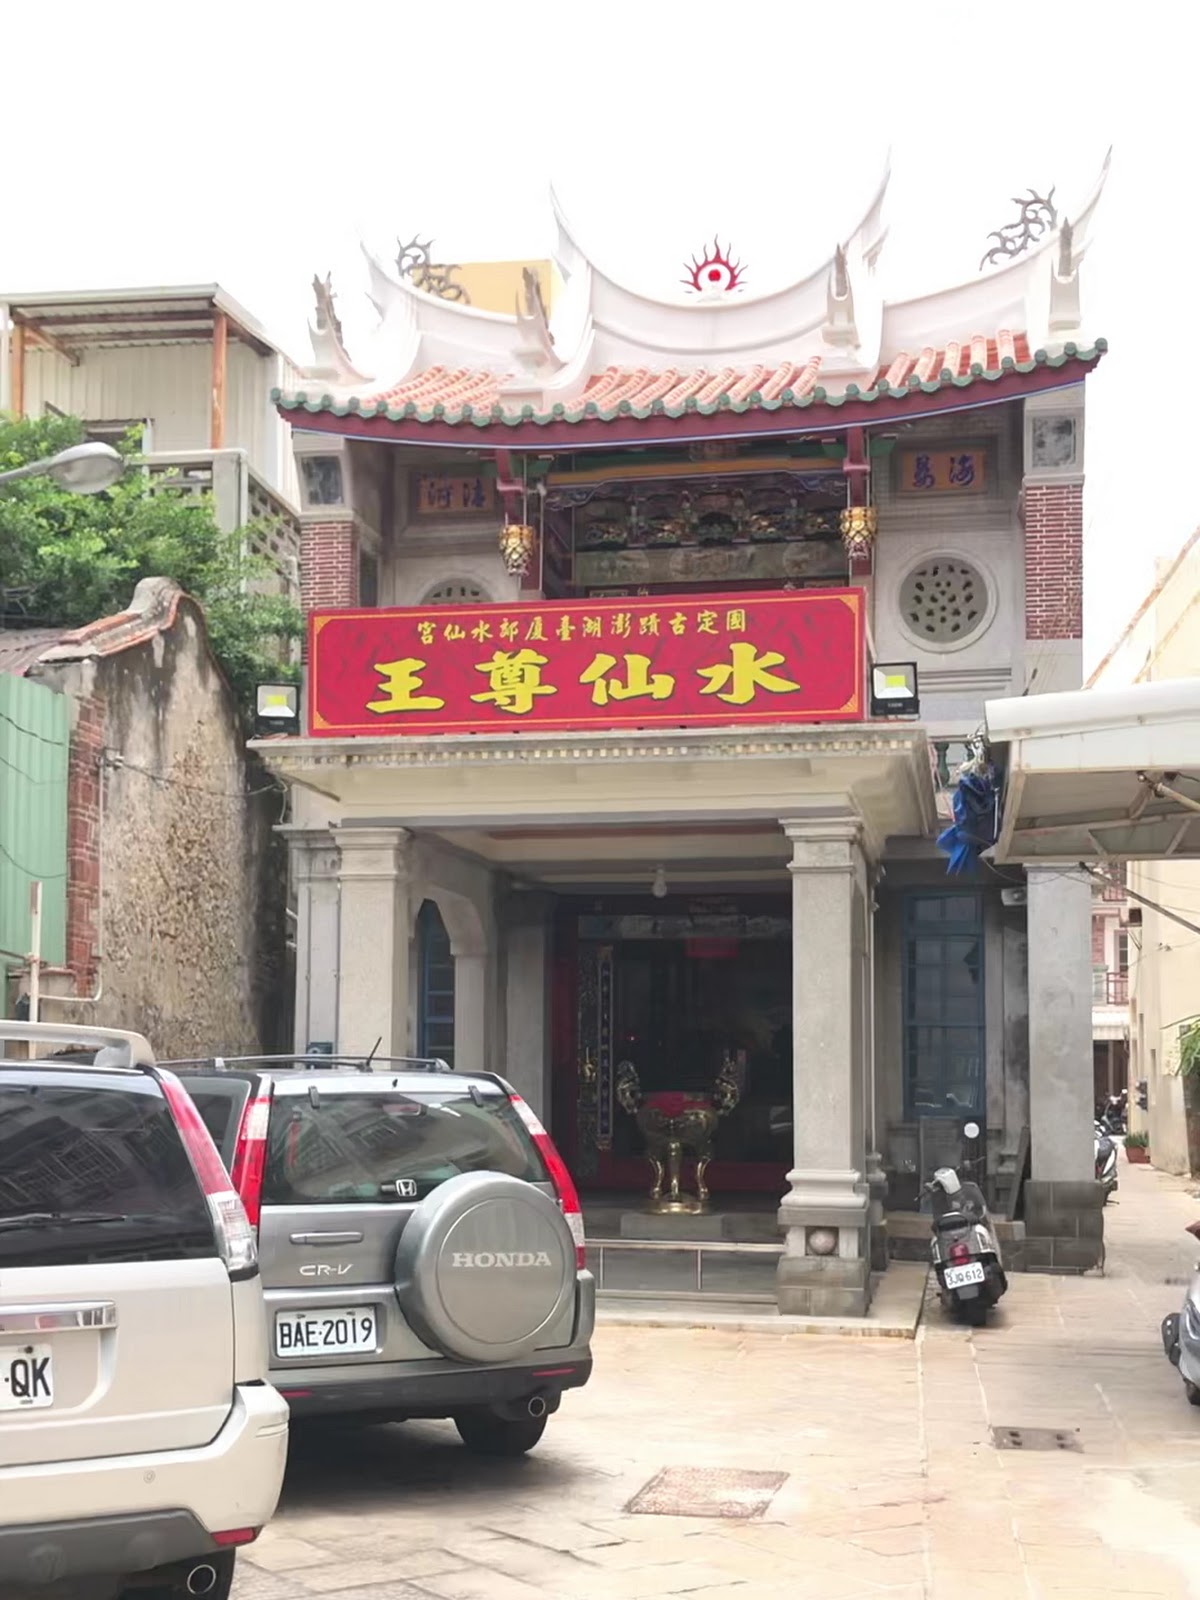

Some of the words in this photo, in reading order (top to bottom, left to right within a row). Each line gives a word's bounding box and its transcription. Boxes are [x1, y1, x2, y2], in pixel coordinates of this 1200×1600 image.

[365, 642, 801, 714] 水仙尊王
[452, 1252, 552, 1268] HONDA
[299, 1264, 354, 1276] CR-V
